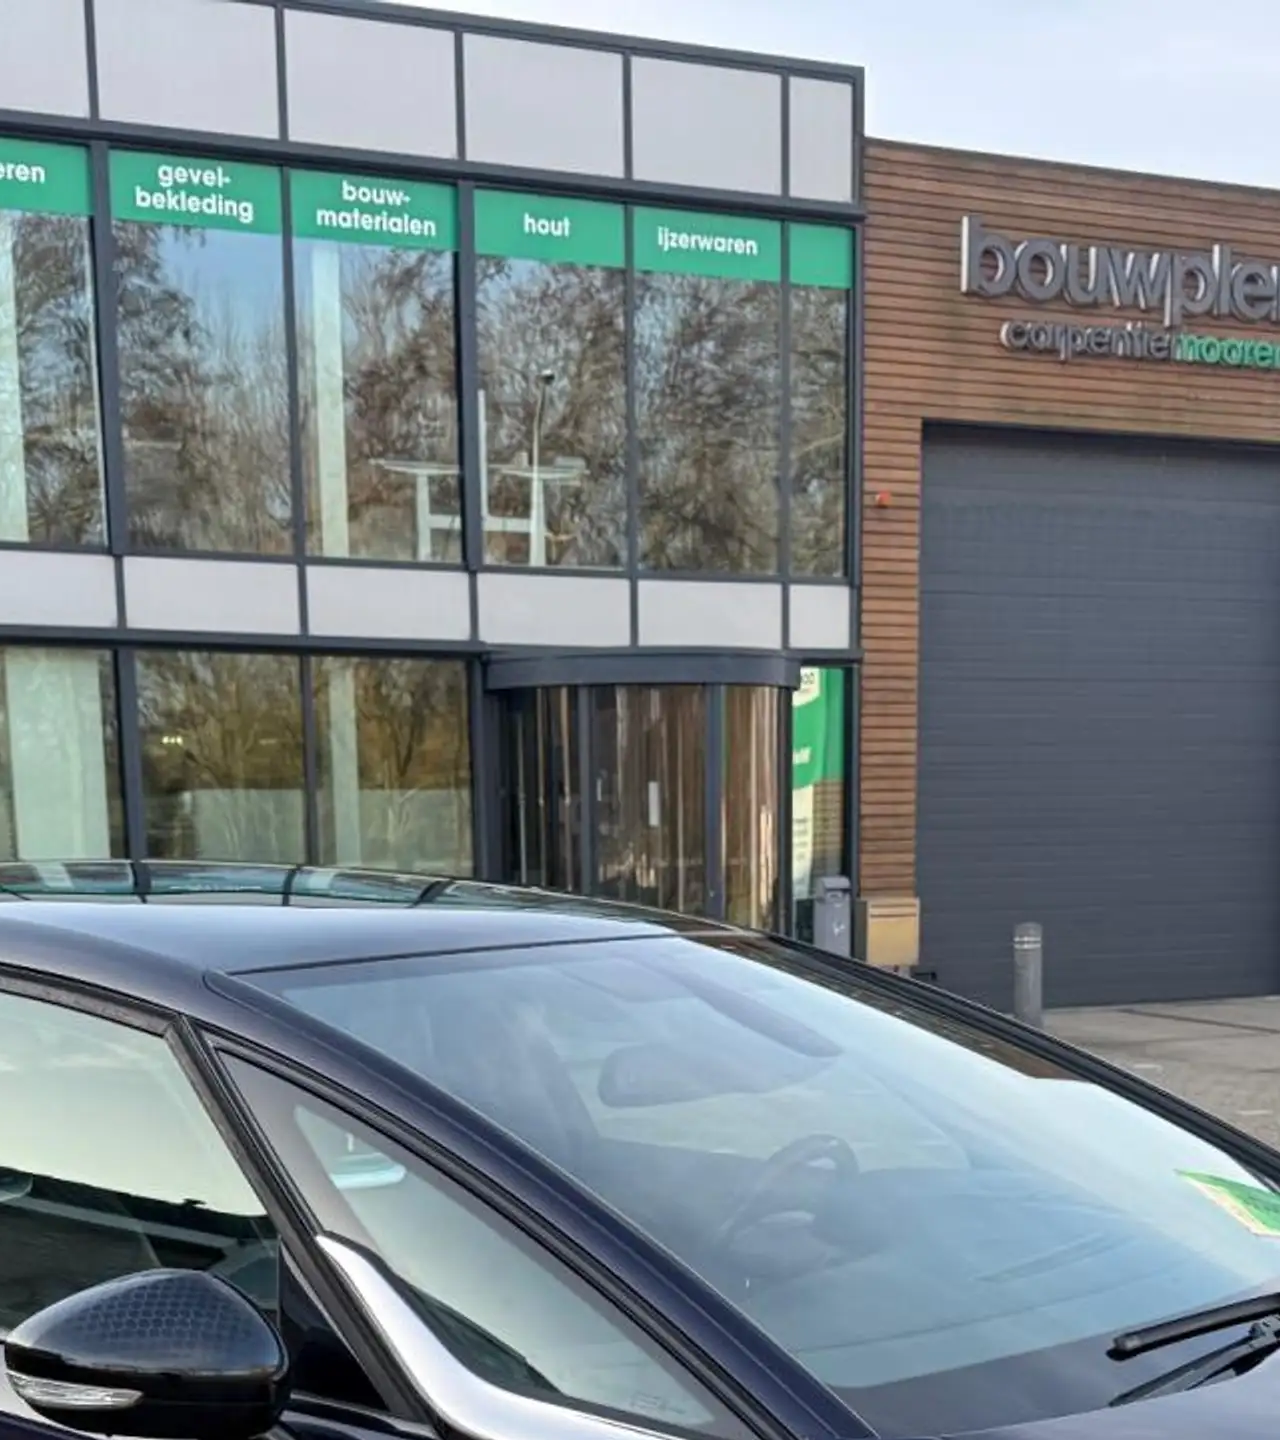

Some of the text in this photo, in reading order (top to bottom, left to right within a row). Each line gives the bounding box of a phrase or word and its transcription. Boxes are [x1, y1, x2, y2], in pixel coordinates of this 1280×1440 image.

[157, 163, 231, 190] gevel-
[135, 186, 254, 224] bekleding
[341, 180, 411, 206] bouw-
[316, 206, 436, 238] materialen
[523, 213, 571, 239] hout
[657, 226, 758, 257] ijzerwaren
